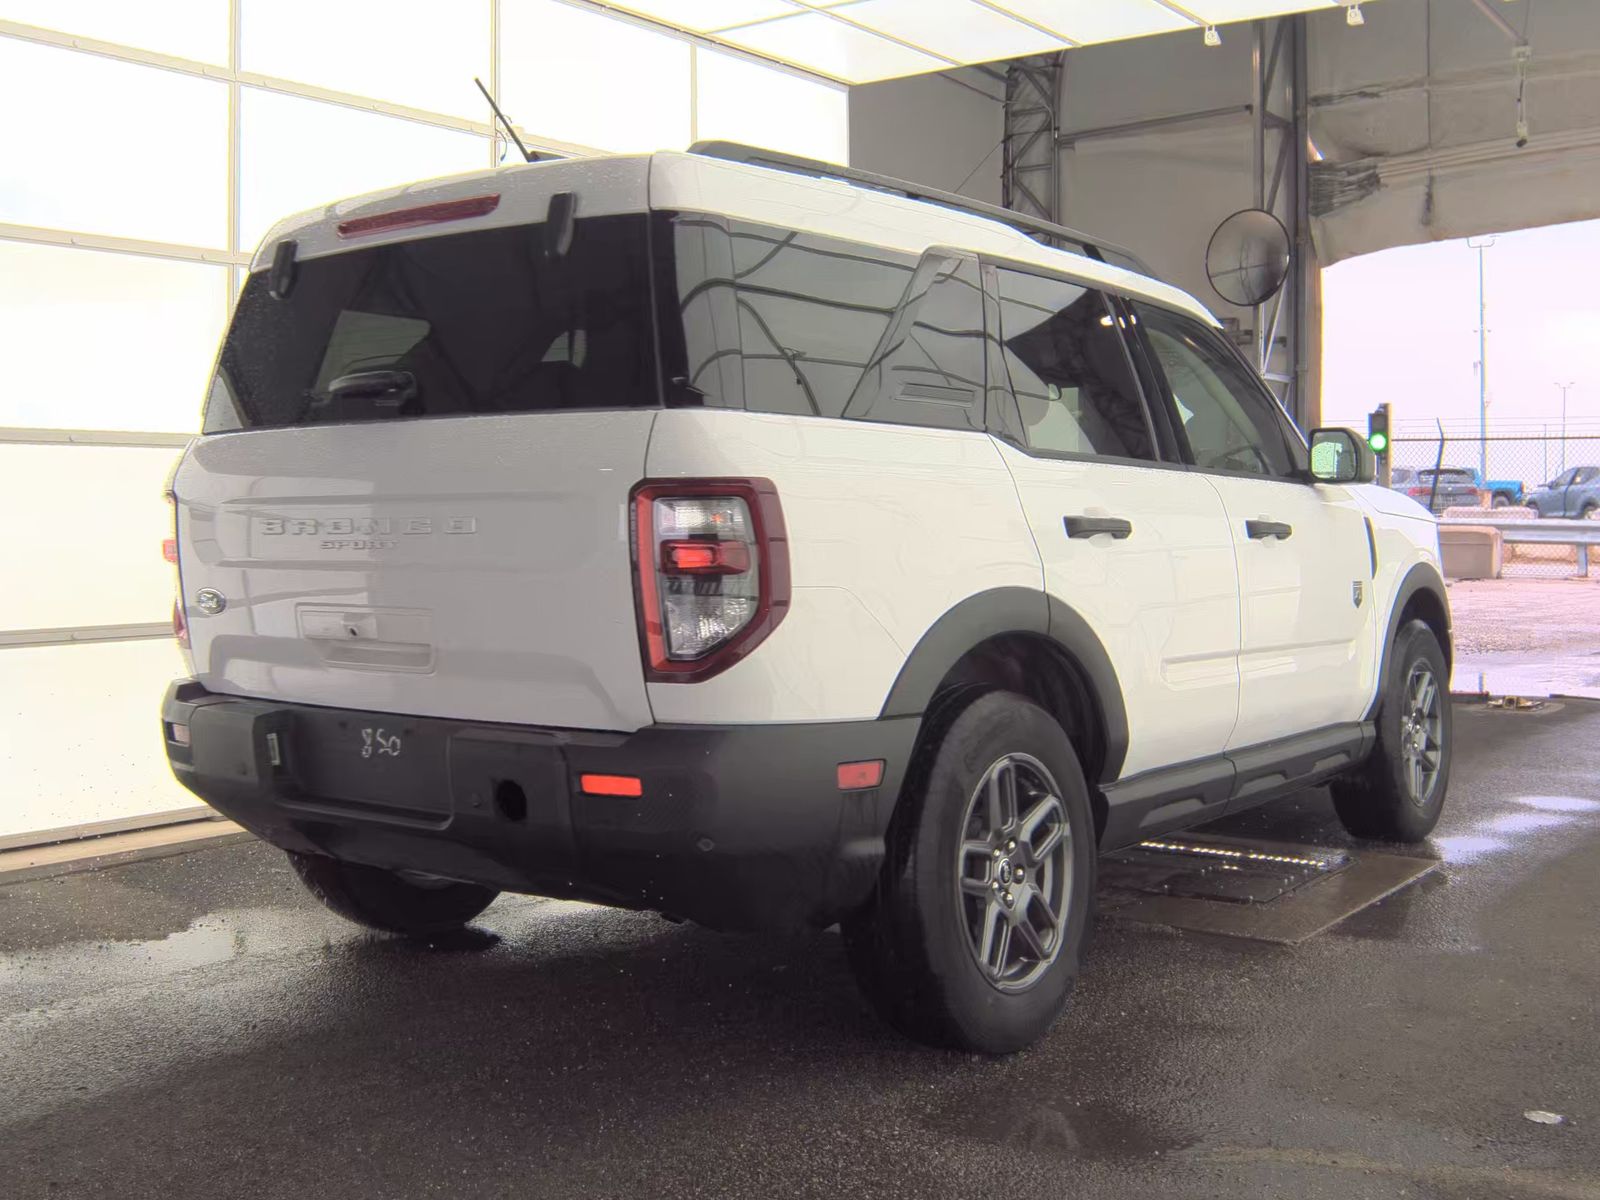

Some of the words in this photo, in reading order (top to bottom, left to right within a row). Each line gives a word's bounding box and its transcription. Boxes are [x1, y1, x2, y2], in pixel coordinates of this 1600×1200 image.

[261, 516, 478, 536] BRONCO
[320, 539, 400, 550] SPORT
[361, 728, 401, 758] 850
